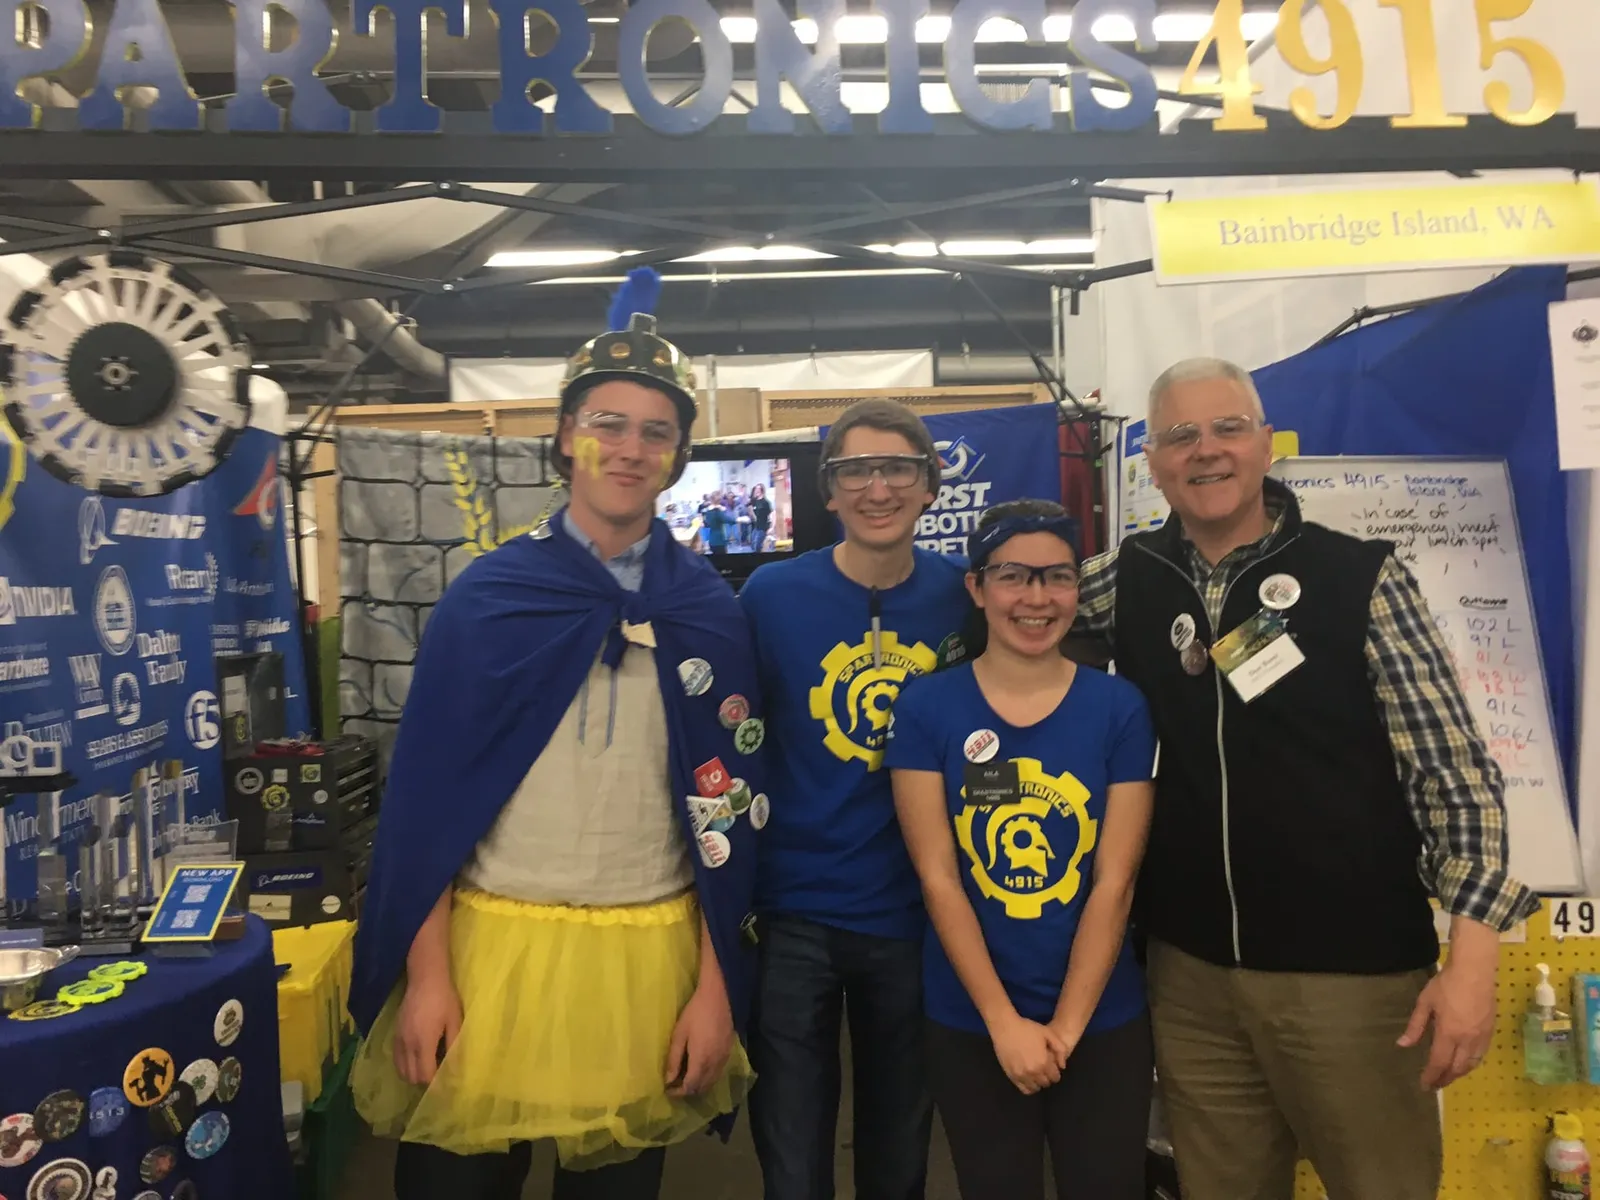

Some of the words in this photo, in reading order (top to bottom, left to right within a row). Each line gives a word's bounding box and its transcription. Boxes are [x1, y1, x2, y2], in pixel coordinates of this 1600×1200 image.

[1179, 0, 1565, 131] 4915
[1219, 213, 1382, 246] Bainbridge
[1392, 206, 1488, 237] Island,
[1497, 204, 1556, 230] WA
[1281, 476, 1336, 489] tronics
[1344, 472, 1389, 490] 4915
[1429, 502, 1450, 519] of
[838, 652, 923, 683] SPARRONIC
[181, 869, 207, 877] NEW
[272, 872, 315, 881] BOEING
[1004, 876, 1044, 889] 4915
[1554, 900, 1595, 934] 49
